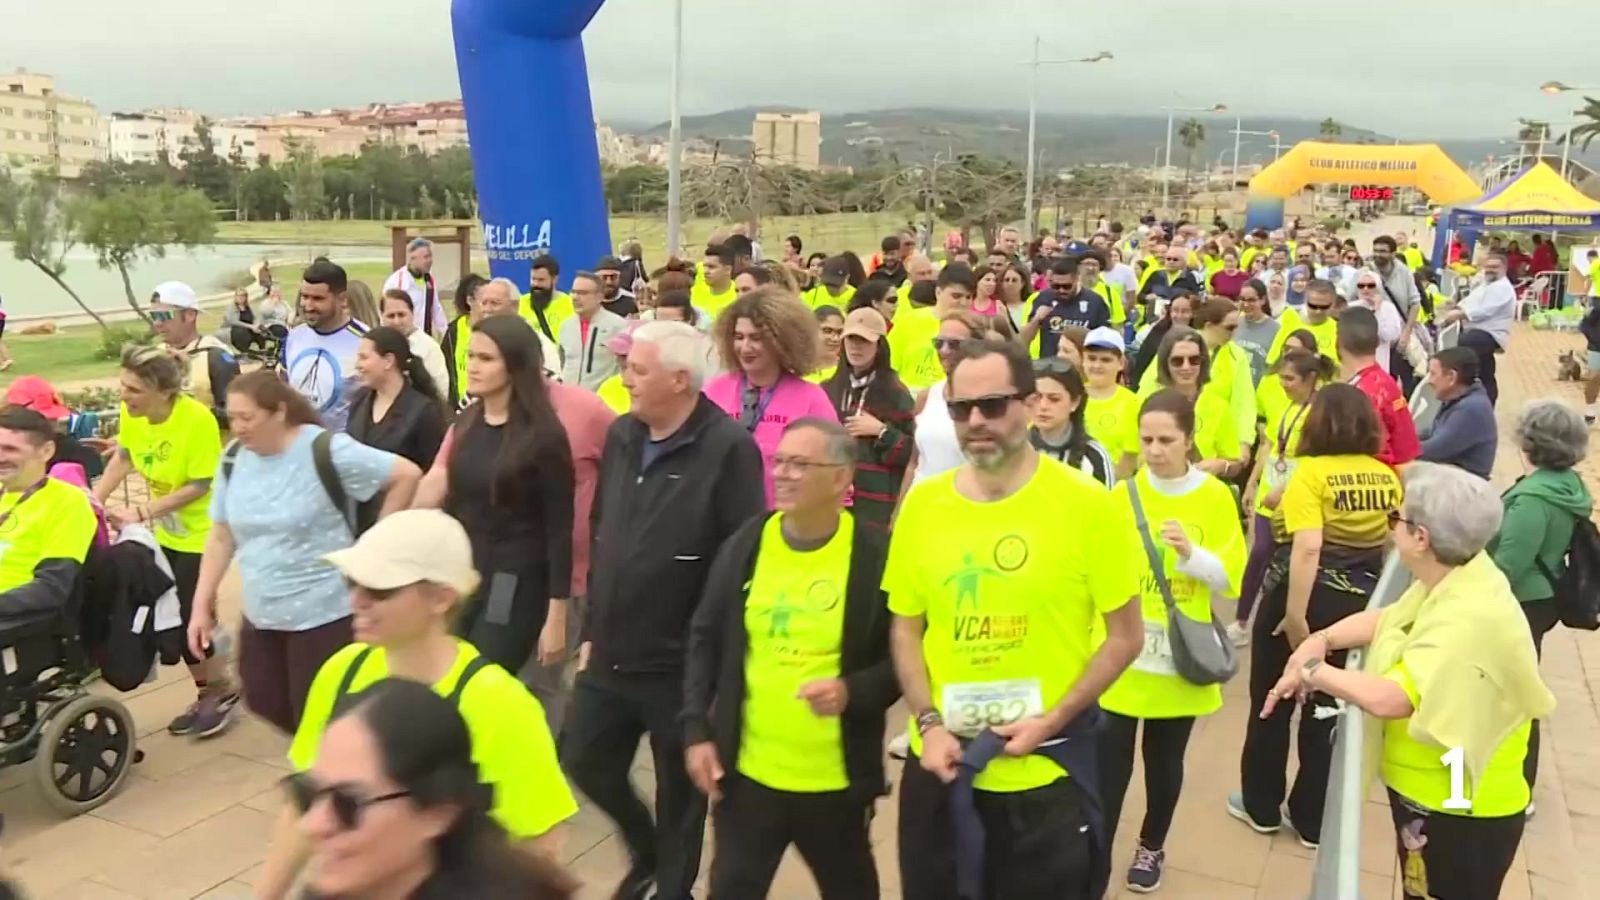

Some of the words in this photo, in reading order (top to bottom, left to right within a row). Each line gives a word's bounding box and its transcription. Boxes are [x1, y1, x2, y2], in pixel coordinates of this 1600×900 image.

[1310, 158, 1334, 169] CLUB
[1484, 215, 1507, 225] CLUB
[1326, 474, 1354, 486] CLUB
[1334, 489, 1398, 511] MELILLA
[954, 616, 991, 641] VCA
[961, 700, 1027, 727] 382
